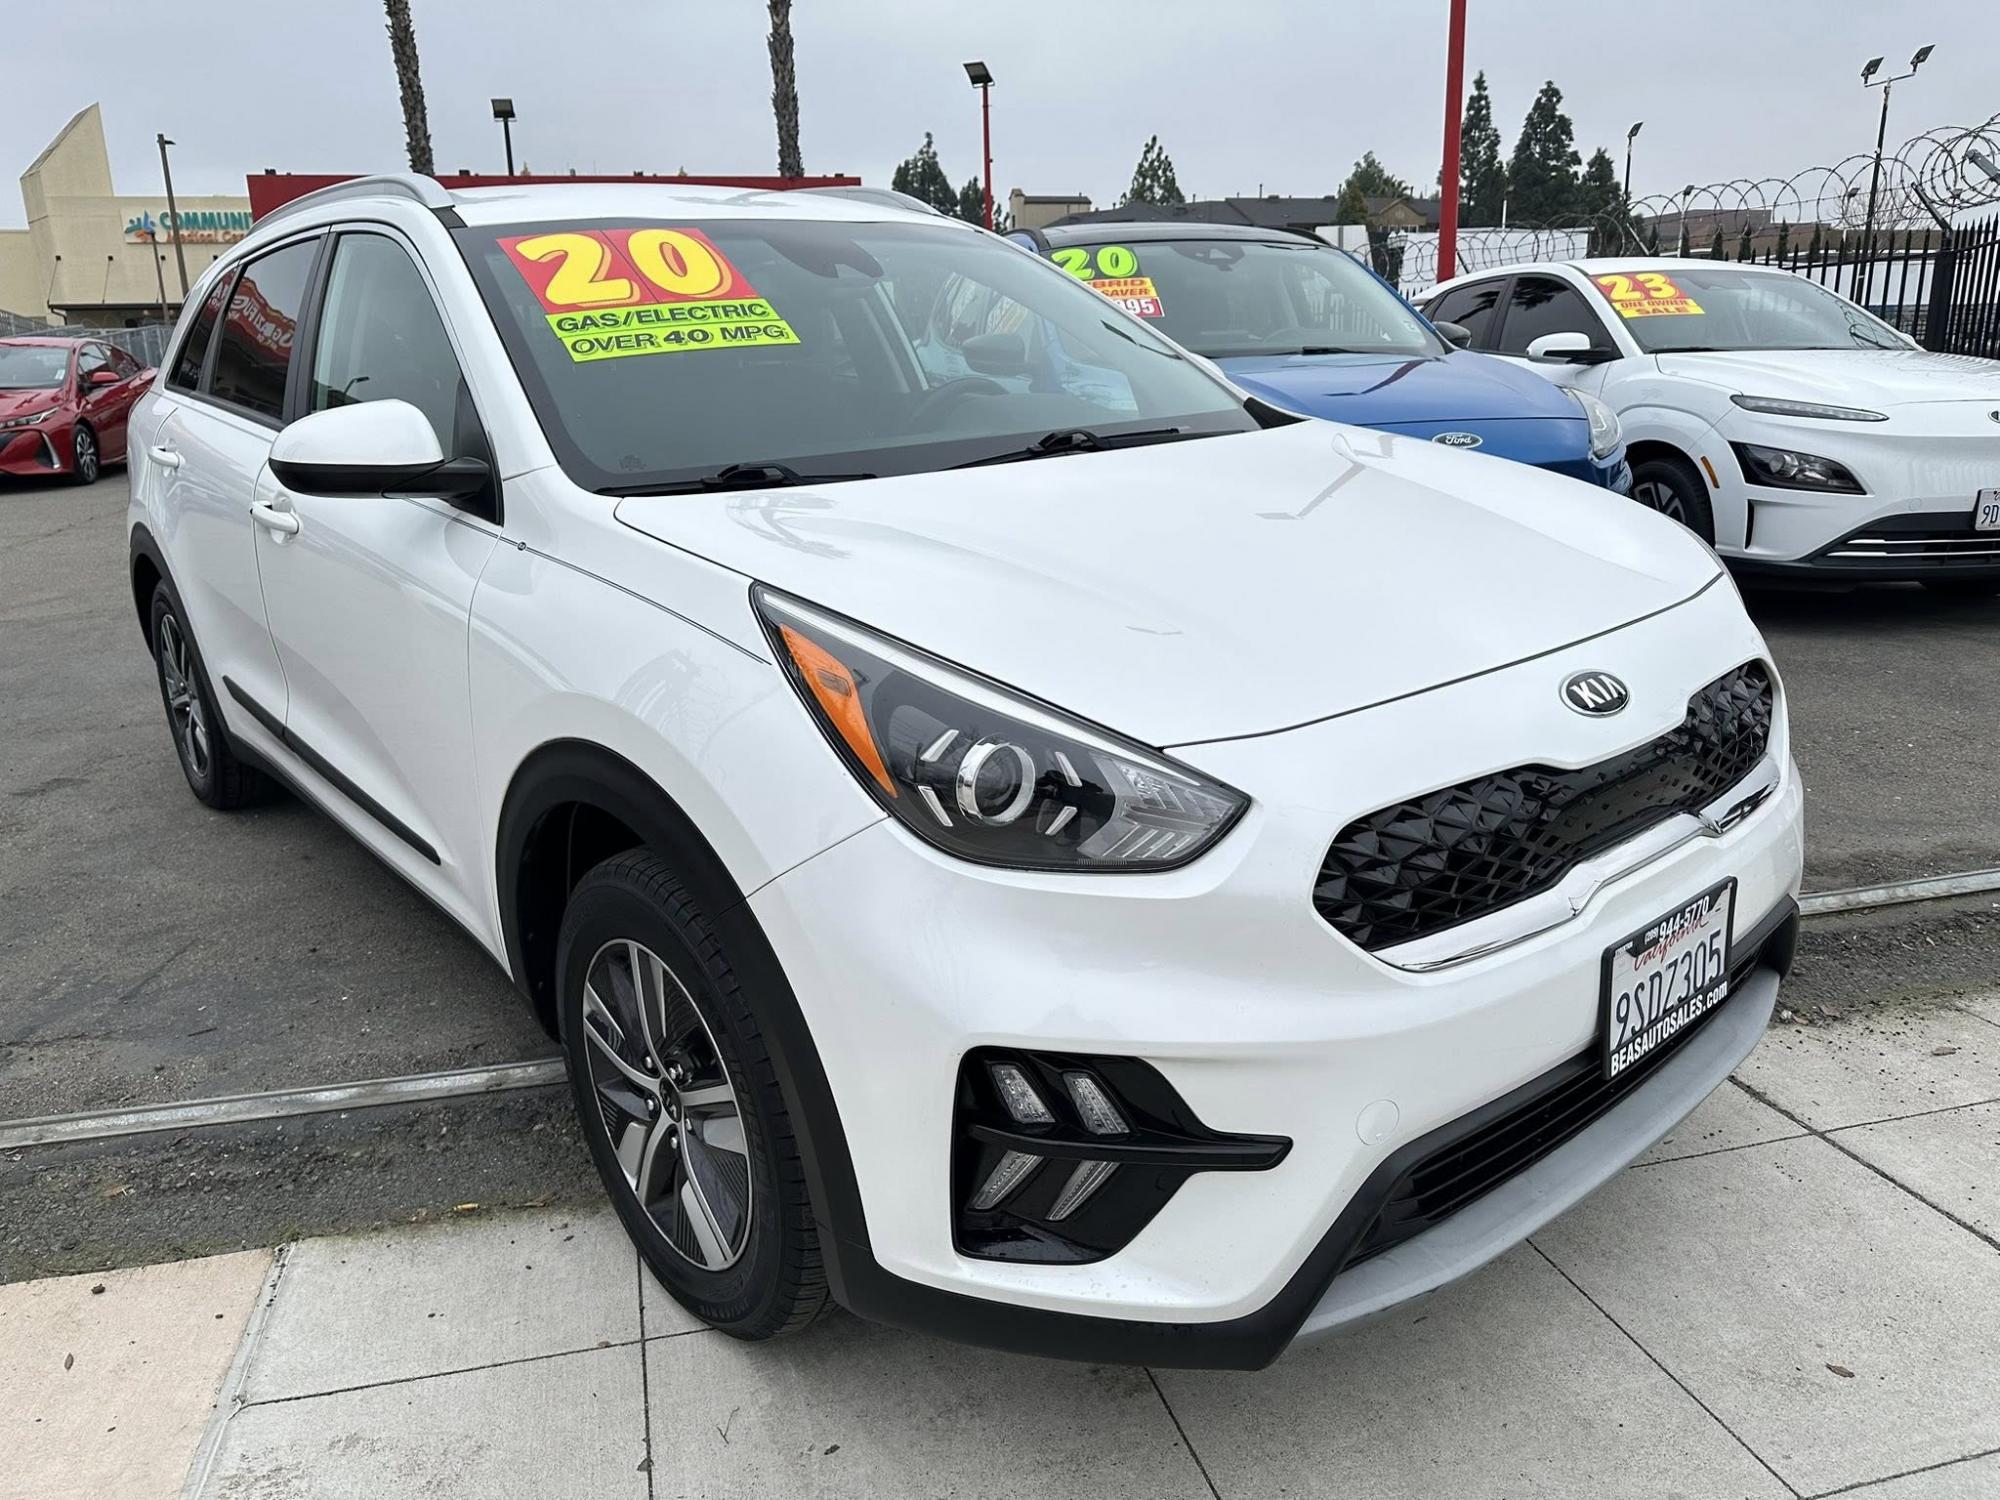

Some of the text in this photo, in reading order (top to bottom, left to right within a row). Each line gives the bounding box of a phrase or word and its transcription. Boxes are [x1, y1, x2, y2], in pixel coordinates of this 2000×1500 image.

[159, 211, 253, 231] COMMUNI
[515, 228, 733, 306] 20
[1051, 246, 1138, 280] 20
[1089, 279, 1147, 289] BRID
[1100, 288, 1150, 297] SAVER
[1597, 272, 1679, 301] 23
[556, 302, 771, 333] GAS/ELECTRIC
[1620, 300, 1689, 309] ONE OWNER
[1636, 307, 1687, 315] SALE
[570, 323, 790, 355] OVER 40 MPG
[1445, 433, 1472, 445] Ford
[1569, 674, 1627, 709] KIA
[1660, 895, 1711, 943] 944-5770
[1634, 915, 1710, 971] California
[1615, 929, 1722, 1050] 9SDZ305
[1610, 981, 1729, 1078] BEASAUTOSALES.com
